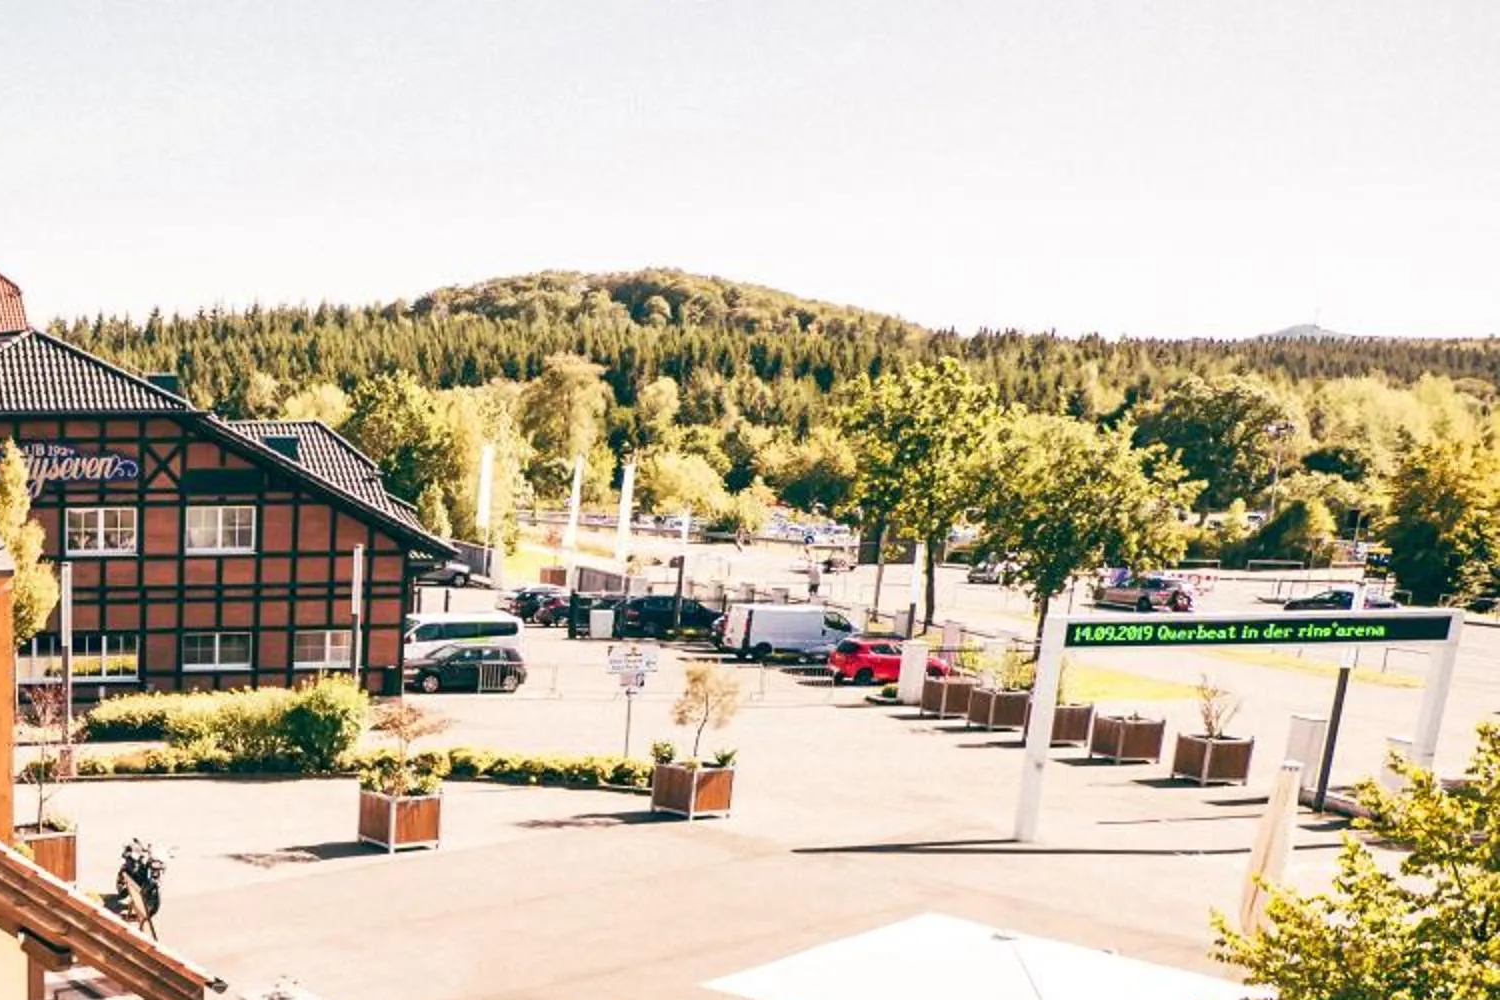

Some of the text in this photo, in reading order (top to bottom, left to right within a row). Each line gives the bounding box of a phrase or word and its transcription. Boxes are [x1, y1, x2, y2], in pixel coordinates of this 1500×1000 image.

[1073, 625, 1154, 641] 14.09.2019
[1158, 624, 1237, 640] Querbeat
[1242, 624, 1259, 638] in
[1264, 623, 1294, 638] der
